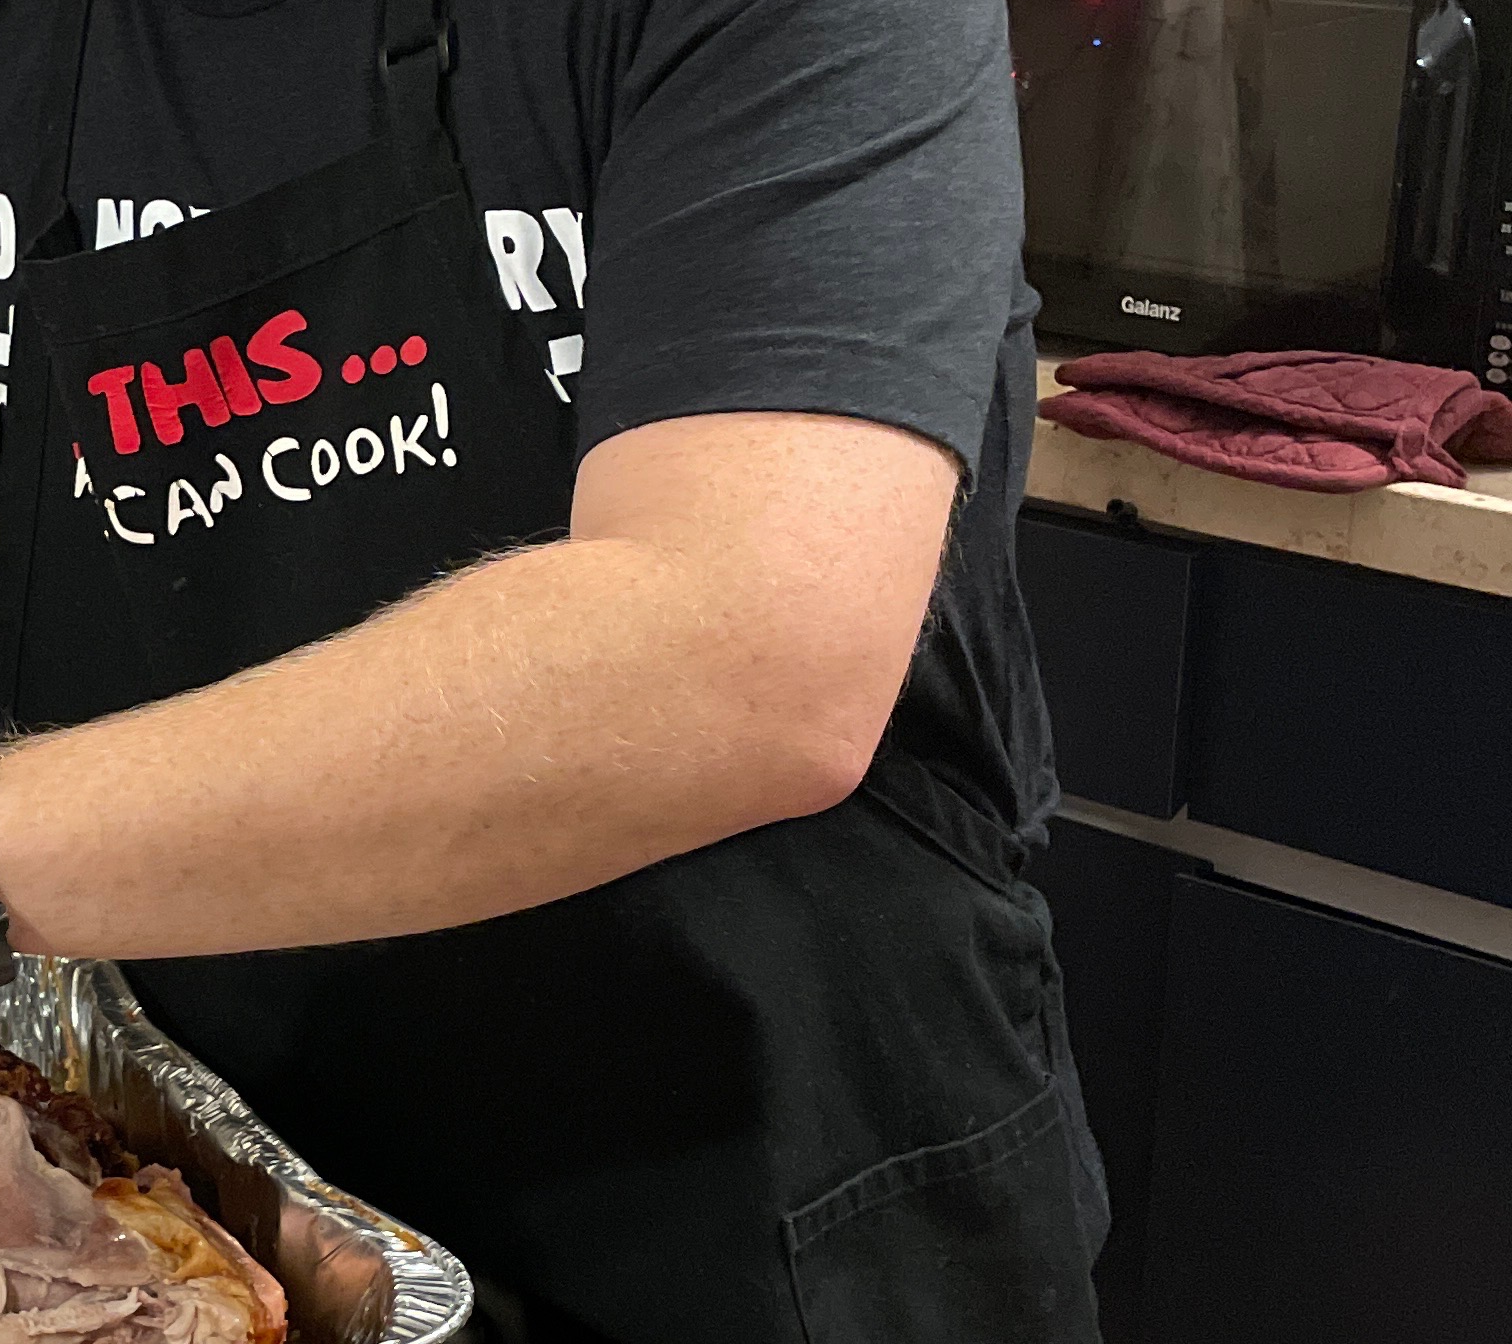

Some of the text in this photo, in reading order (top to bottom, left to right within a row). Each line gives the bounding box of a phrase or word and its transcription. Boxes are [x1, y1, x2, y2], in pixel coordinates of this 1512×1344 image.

[1120, 295, 1183, 322] Galanz
[103, 453, 244, 545] CAN
[262, 382, 458, 503] COOK!
